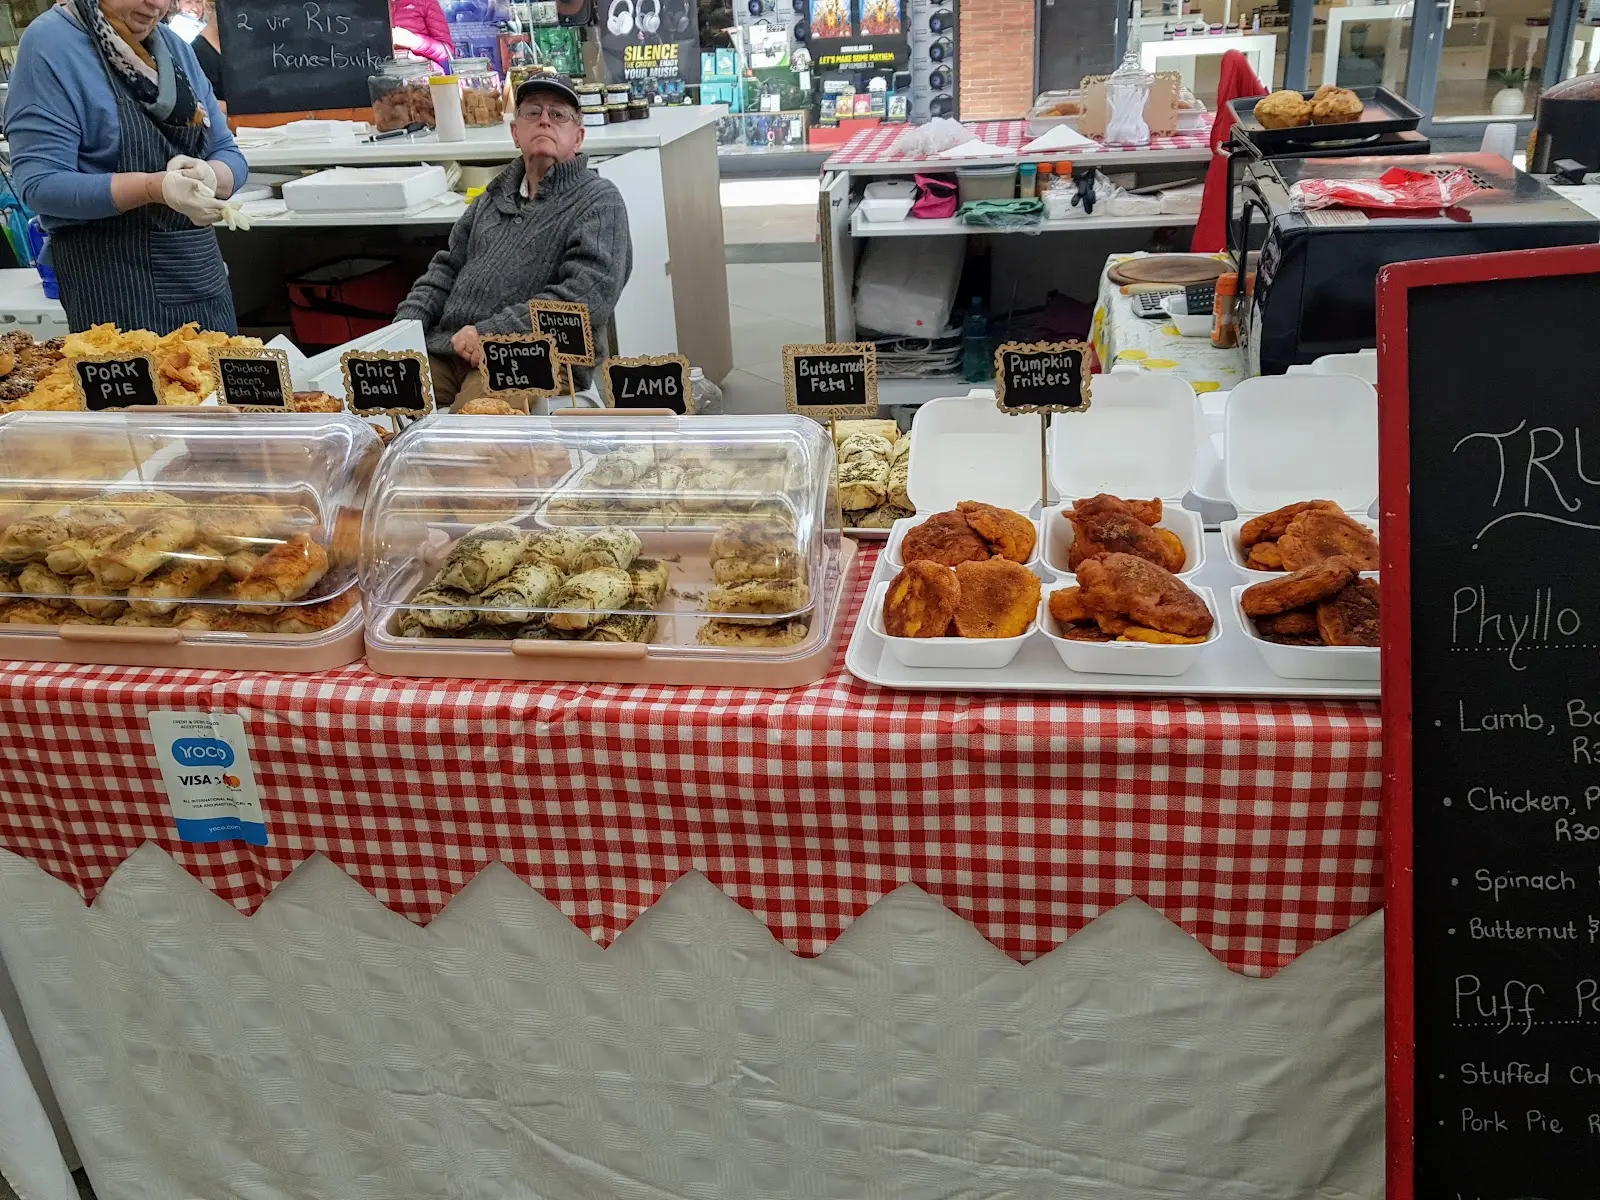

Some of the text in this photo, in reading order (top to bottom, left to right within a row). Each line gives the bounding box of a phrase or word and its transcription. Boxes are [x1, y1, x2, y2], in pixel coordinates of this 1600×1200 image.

[237, 2, 351, 35] 2 vir R15
[624, 43, 679, 62] SILENCE
[819, 52, 895, 64] LET'S MAKE SOME MAYHEM
[624, 61, 635, 69] THE
[660, 59, 679, 67] ENJOY
[624, 66, 679, 79] YOUR MUSIC
[539, 313, 580, 328] Chicken
[550, 328, 569, 344] Pie
[489, 344, 545, 365] Spinach
[85, 361, 140, 383] PORK
[224, 362, 270, 376] Chicken,
[355, 362, 394, 378] Chic
[799, 358, 865, 377] Butternut
[1010, 354, 1073, 378] Pumpkin
[227, 375, 265, 388] Bacon,
[361, 380, 398, 396] Basil
[497, 372, 530, 387] Feta
[621, 376, 678, 398] LAMB
[811, 377, 846, 393] Feta
[1013, 372, 1071, 389] Fritters
[100, 383, 137, 400] PIE
[229, 387, 252, 398] Feta
[1453, 584, 1580, 671] Phyllo
[1459, 700, 1555, 735] Lamb,
[177, 775, 212, 786] VISA
[1467, 786, 1576, 815] Chicken,
[1475, 868, 1575, 902] Spinach
[1469, 917, 1578, 940] Butternut
[1456, 974, 1544, 1035] Puff
[1461, 1062, 1549, 1085] Stuffed
[1461, 1108, 1508, 1132] Pork
[1526, 1110, 1563, 1133] Pie
